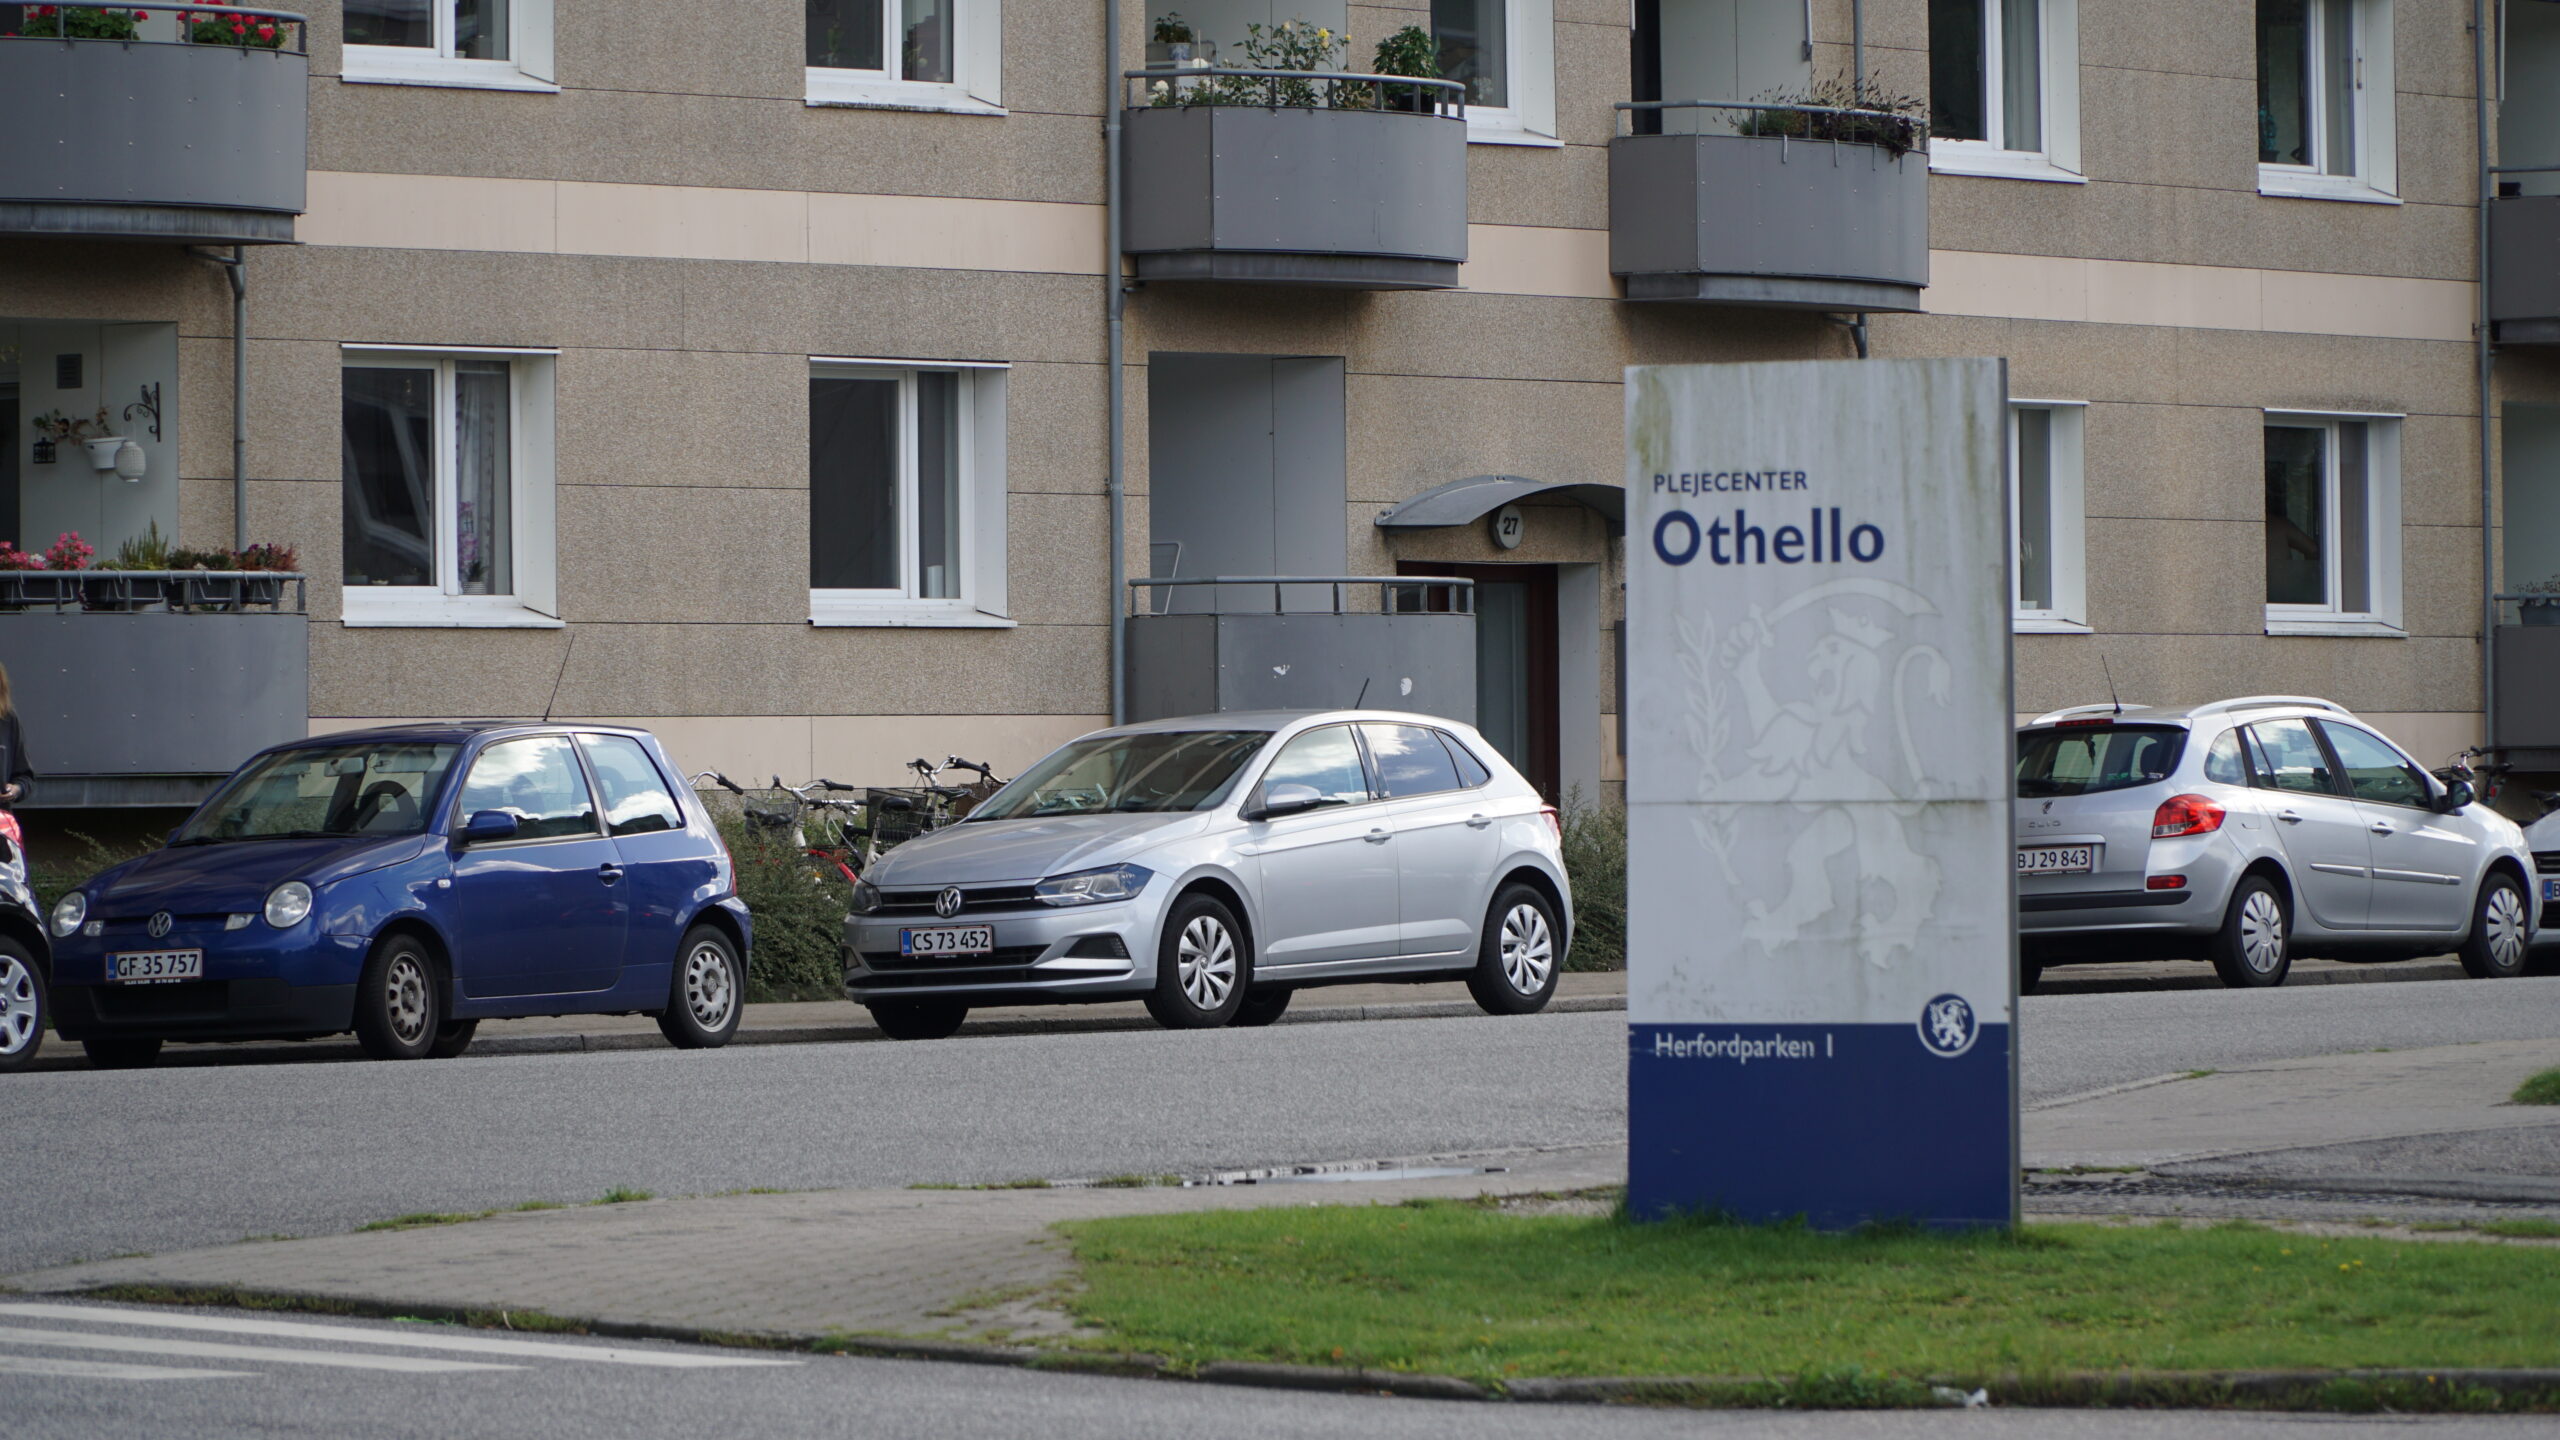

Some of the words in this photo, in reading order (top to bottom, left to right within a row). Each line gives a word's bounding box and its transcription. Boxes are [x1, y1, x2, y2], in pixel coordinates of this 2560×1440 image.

[1653, 471, 1809, 498] PLEJECENTER
[1503, 516, 1519, 535] 27
[1652, 507, 1885, 567] Othello
[2017, 852, 2036, 869] BJ
[2039, 851, 2057, 868] 29
[2060, 849, 2088, 867] 843
[912, 933, 933, 951] CS
[936, 931, 956, 950] 73
[960, 930, 989, 949] 452
[117, 957, 138, 977] GF
[142, 955, 163, 975] 35
[167, 953, 198, 974] 757
[1655, 1031, 1816, 1065] Herfordparken
